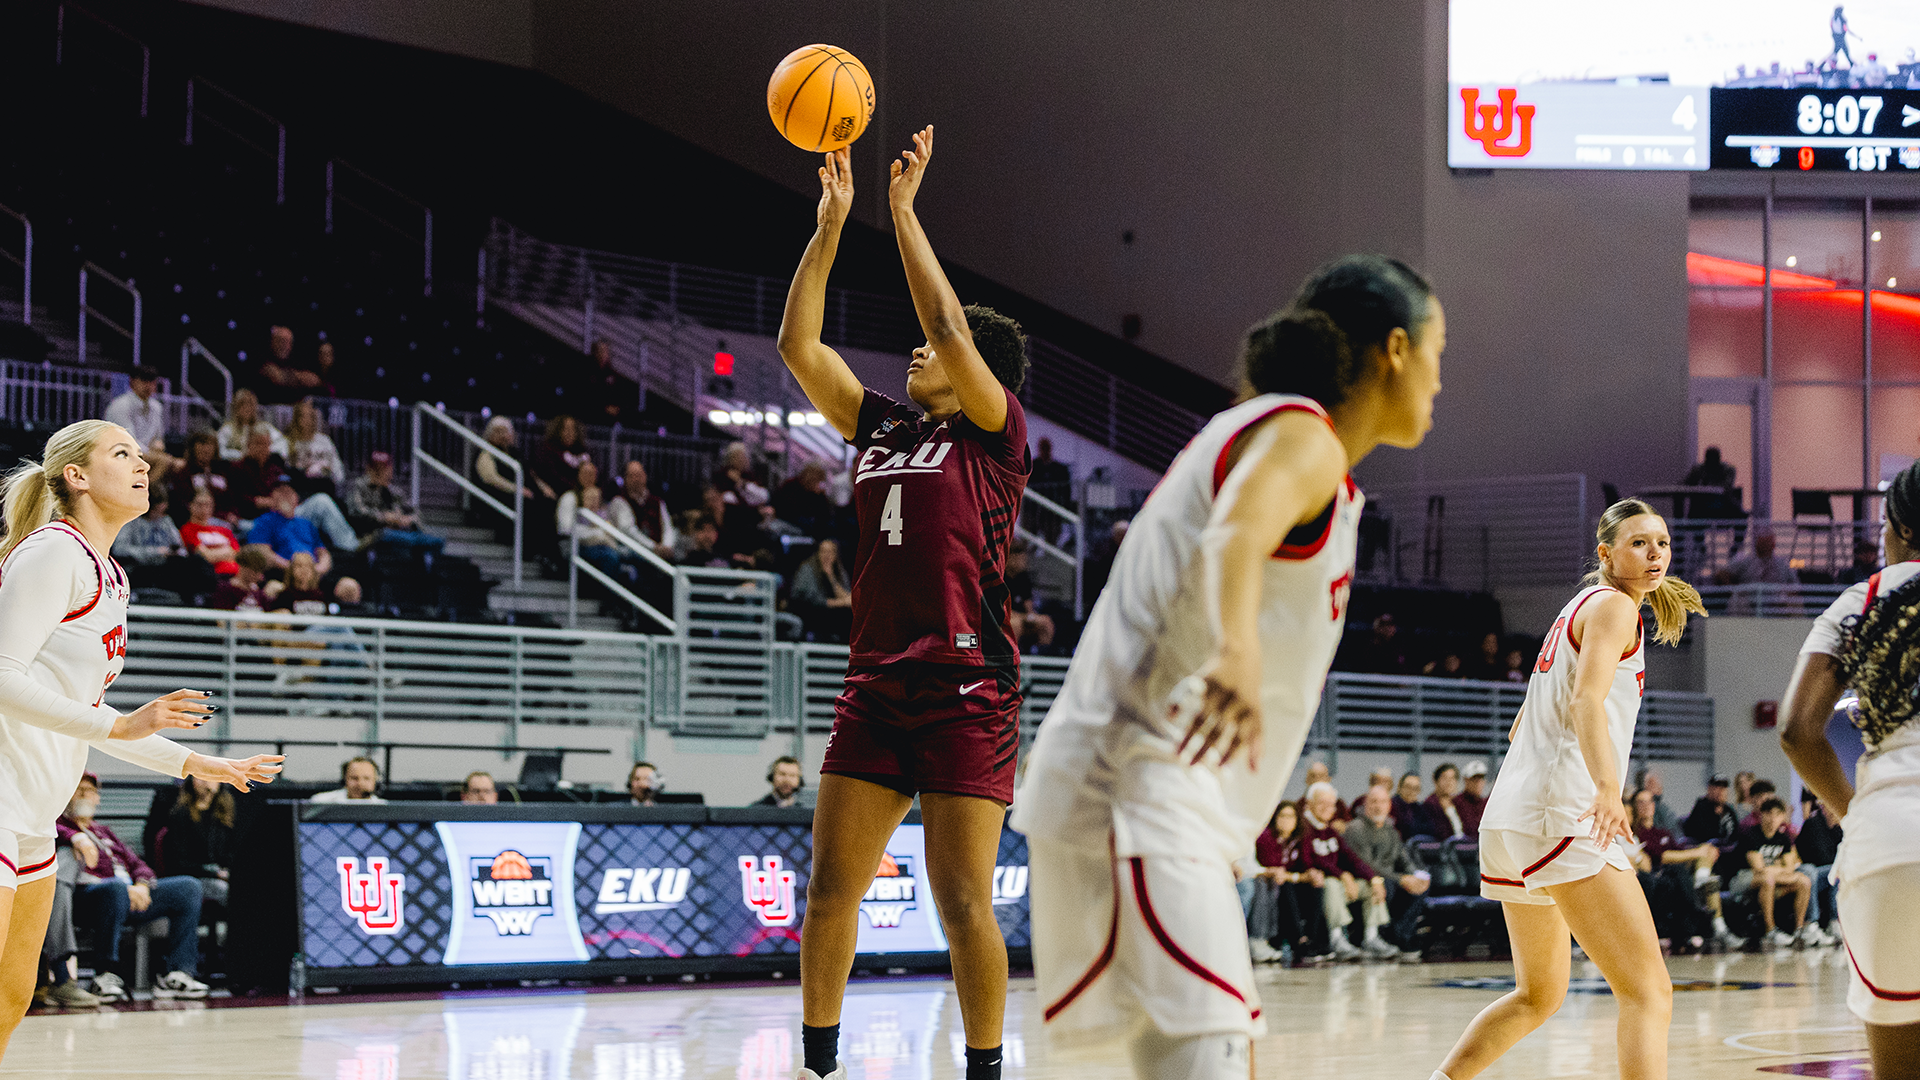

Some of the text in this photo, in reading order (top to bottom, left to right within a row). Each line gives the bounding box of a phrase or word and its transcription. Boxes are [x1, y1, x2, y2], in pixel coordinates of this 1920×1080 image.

[1671, 95, 1697, 131] 4
[1797, 95, 1884, 135] 8:07
[1845, 146, 1892, 171] 1ST
[880, 484, 903, 545] 4
[472, 880, 552, 906] WBIT
[598, 867, 691, 903] EKU
